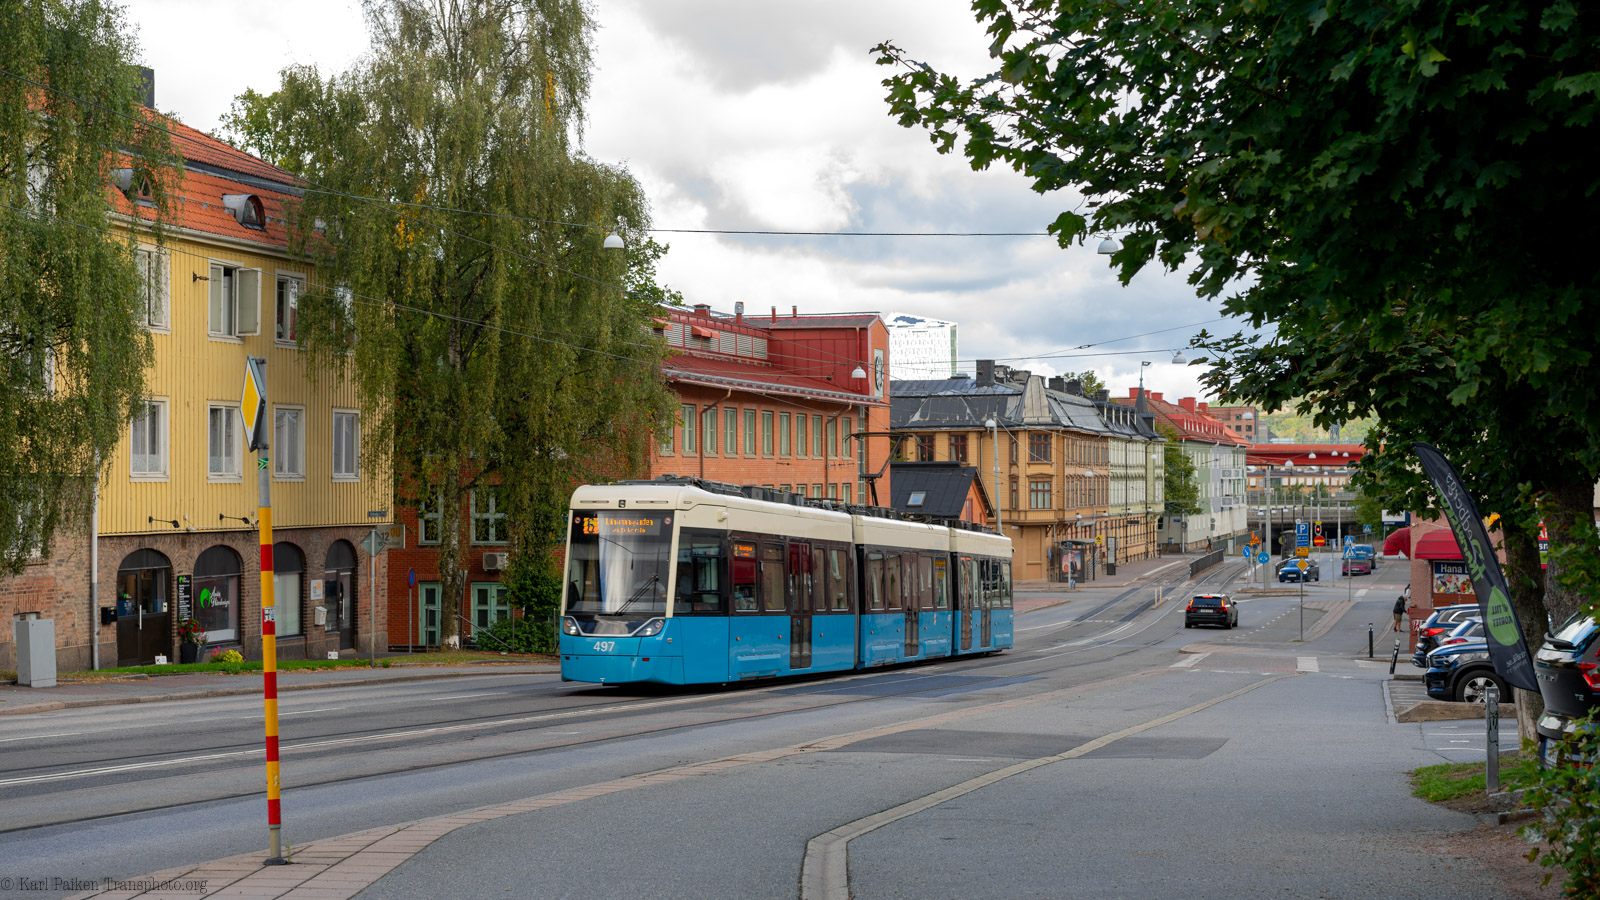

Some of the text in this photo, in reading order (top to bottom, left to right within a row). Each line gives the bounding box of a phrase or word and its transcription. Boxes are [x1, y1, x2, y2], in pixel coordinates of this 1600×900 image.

[1299, 524, 1306, 534] P
[1440, 563, 1463, 573] Hana
[593, 641, 615, 652] 497
